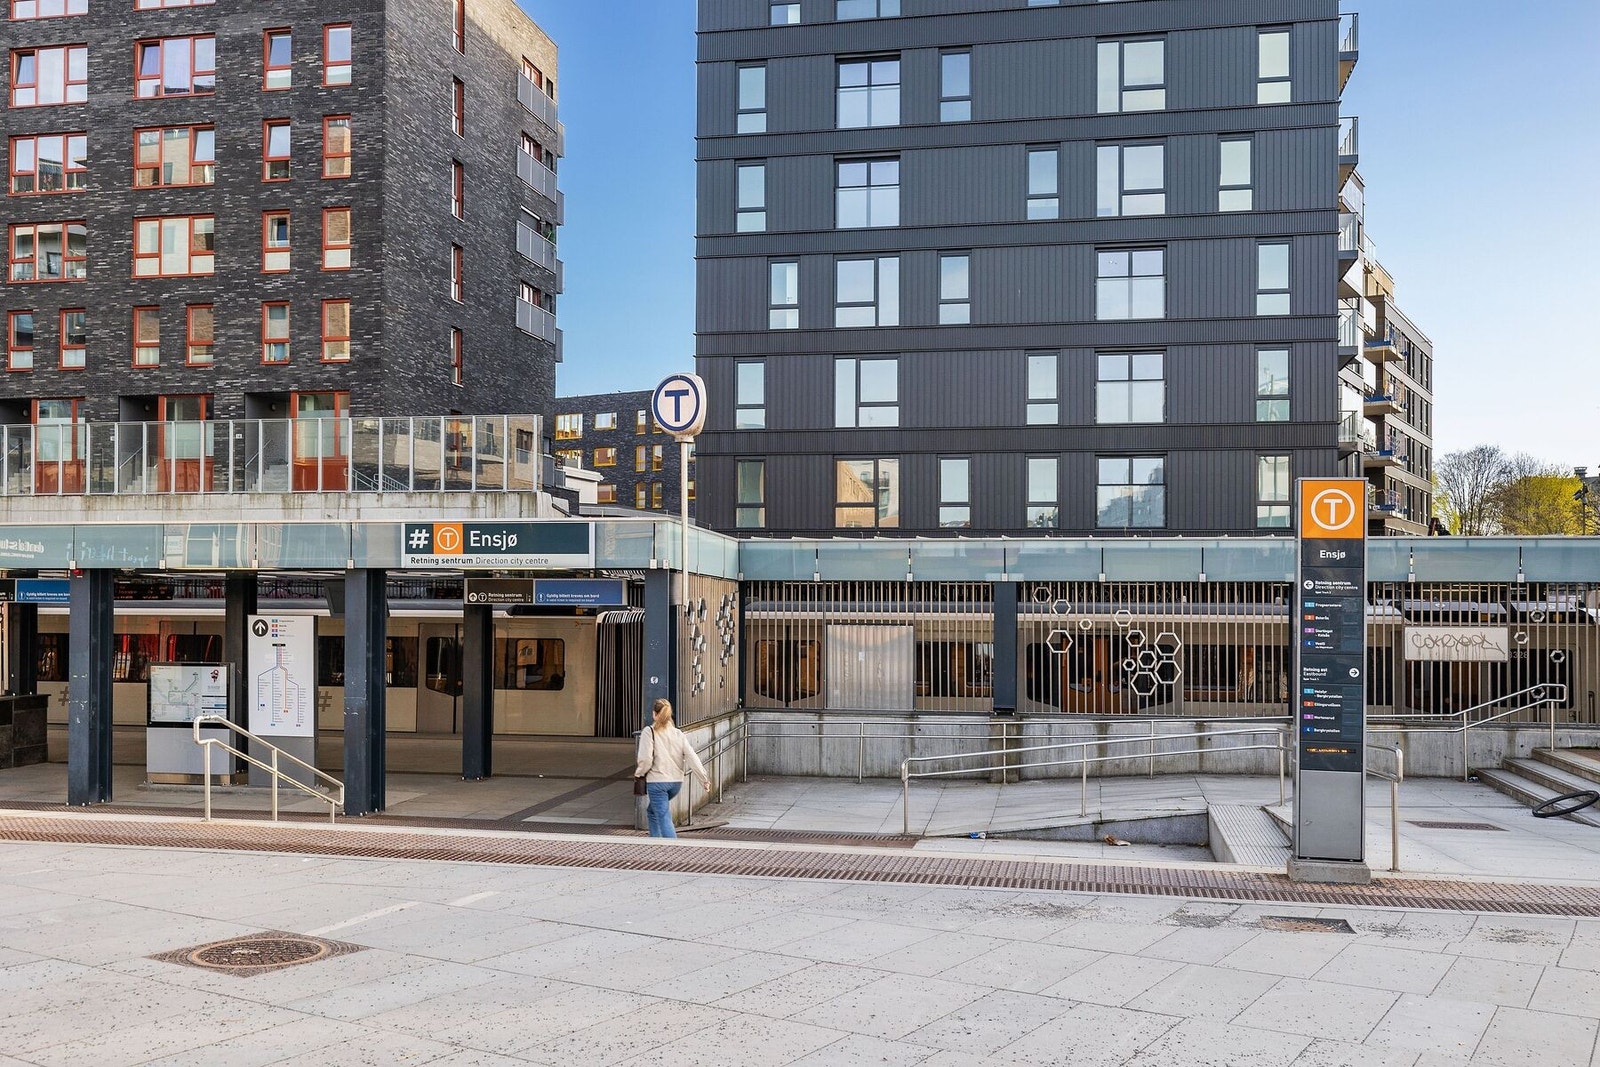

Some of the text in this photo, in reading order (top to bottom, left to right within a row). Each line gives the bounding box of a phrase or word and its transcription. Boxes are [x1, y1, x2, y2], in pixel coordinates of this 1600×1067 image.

[665, 389, 689, 422] T
[1323, 498, 1343, 525] T
[469, 530, 518, 551] Ensjø
[410, 557, 440, 565] Retning
[509, 557, 523, 566] city
[1319, 549, 1346, 560] Ensjø
